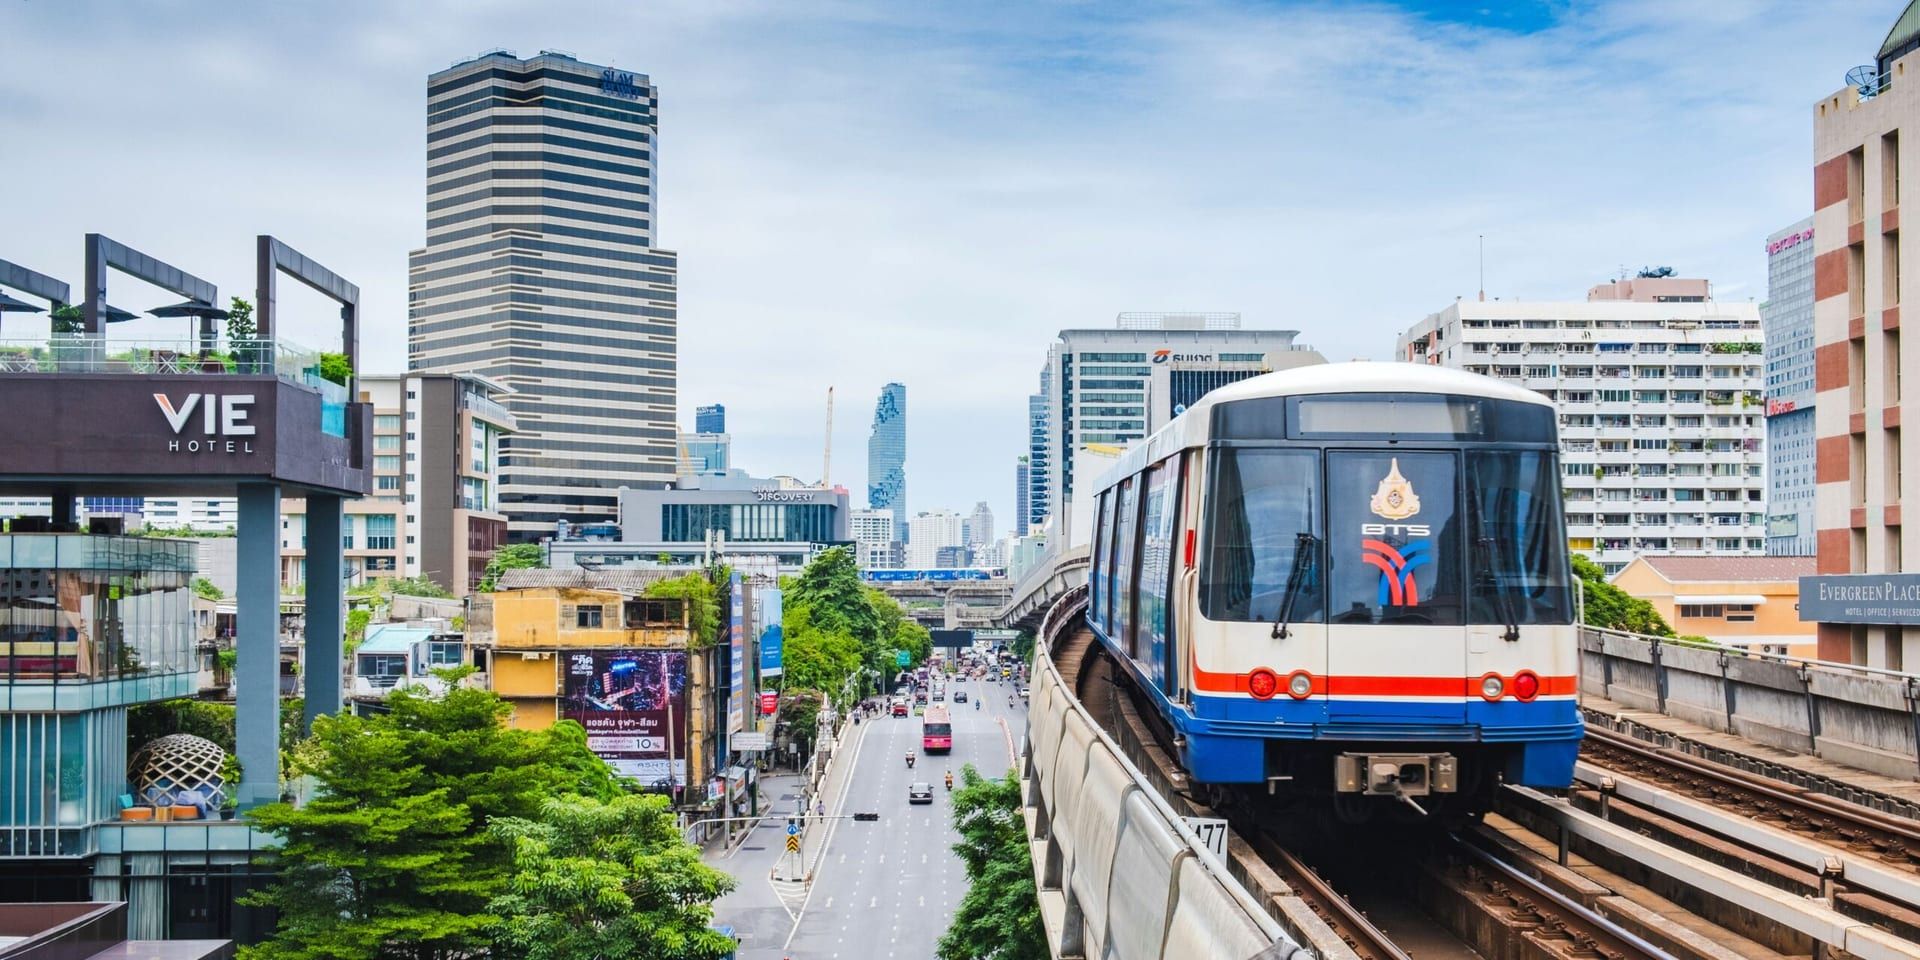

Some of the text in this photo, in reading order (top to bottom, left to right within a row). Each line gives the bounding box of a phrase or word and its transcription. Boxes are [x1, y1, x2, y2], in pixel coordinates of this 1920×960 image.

[603, 70, 634, 86] SIAM
[153, 393, 256, 435] VIE
[169, 440, 253, 453] HOTEL
[757, 492, 815, 501] DISCOVERY
[1361, 523, 1431, 536] BTS
[1845, 608, 1862, 616] HOTEL
[1867, 608, 1887, 616] OFFICE
